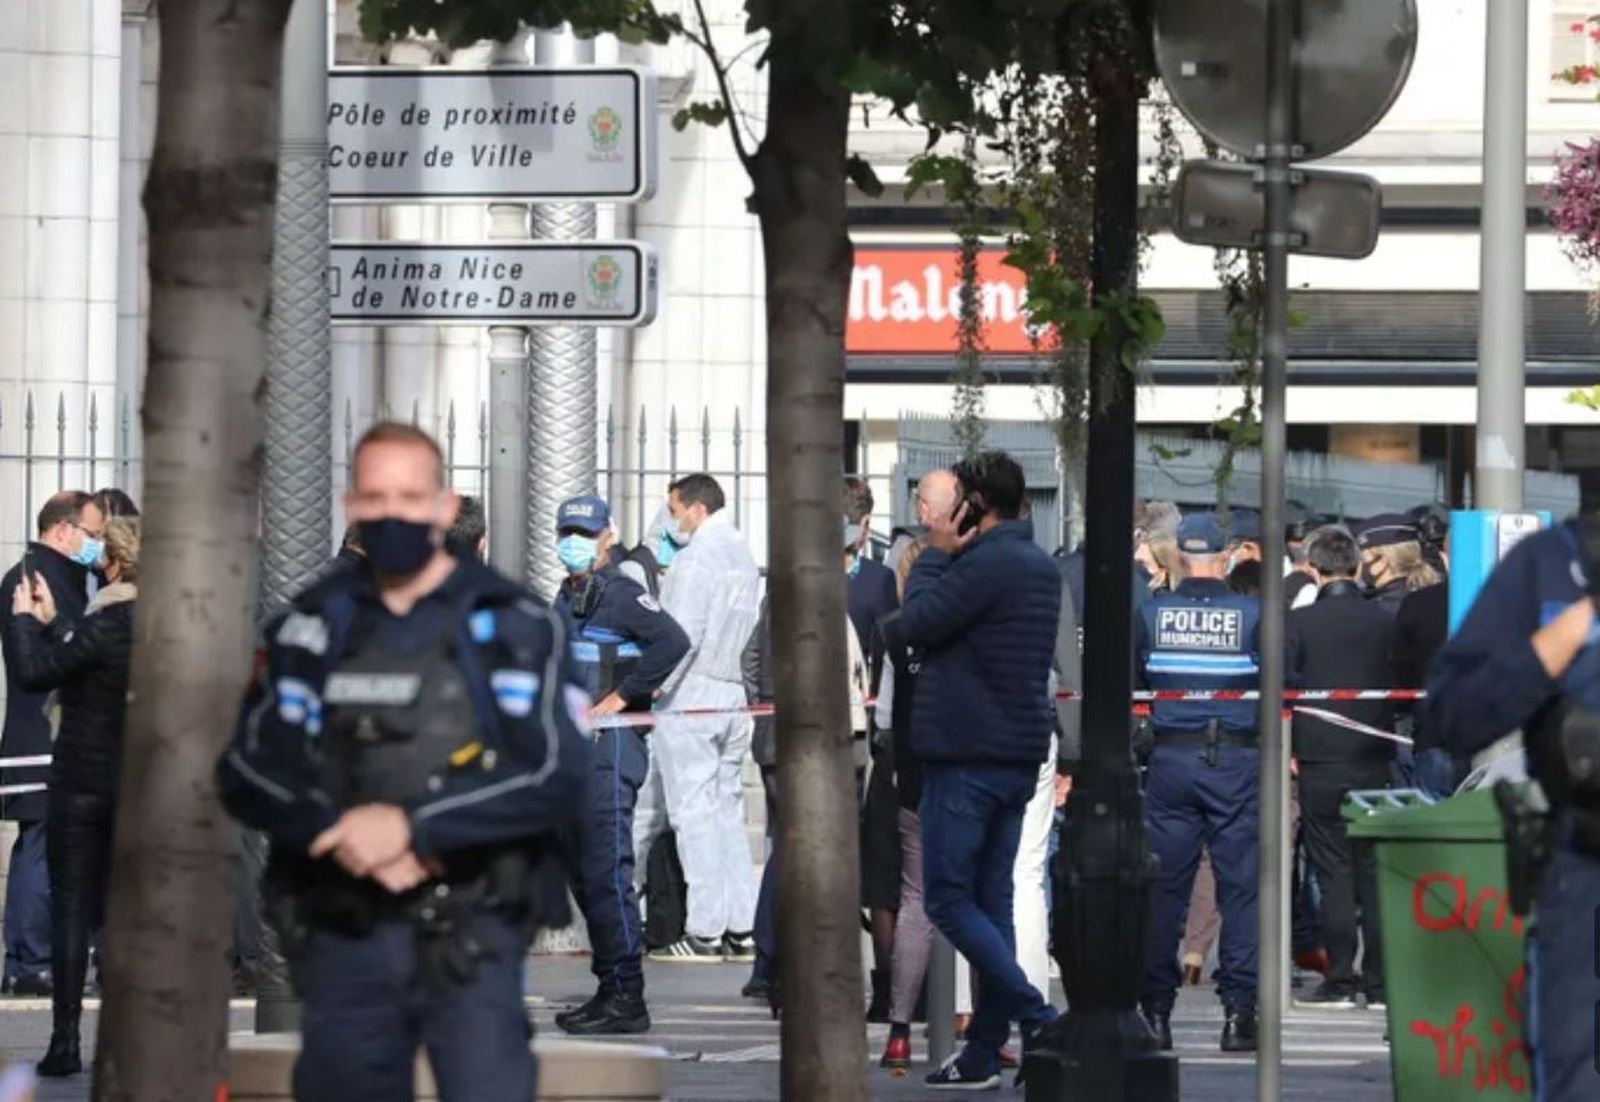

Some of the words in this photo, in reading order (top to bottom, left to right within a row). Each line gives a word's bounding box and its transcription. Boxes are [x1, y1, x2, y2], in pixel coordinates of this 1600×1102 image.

[327, 103, 386, 126] Pôle
[401, 103, 430, 126] de
[443, 102, 576, 129] proximité
[327, 145, 409, 168] Coeur
[423, 145, 454, 168] de
[470, 145, 533, 168] Ville
[351, 257, 442, 280] Anima
[459, 257, 524, 280] Nice
[352, 287, 383, 309] de
[401, 287, 576, 309] Notre-Dame
[1160, 611, 1237, 632] POLICE
